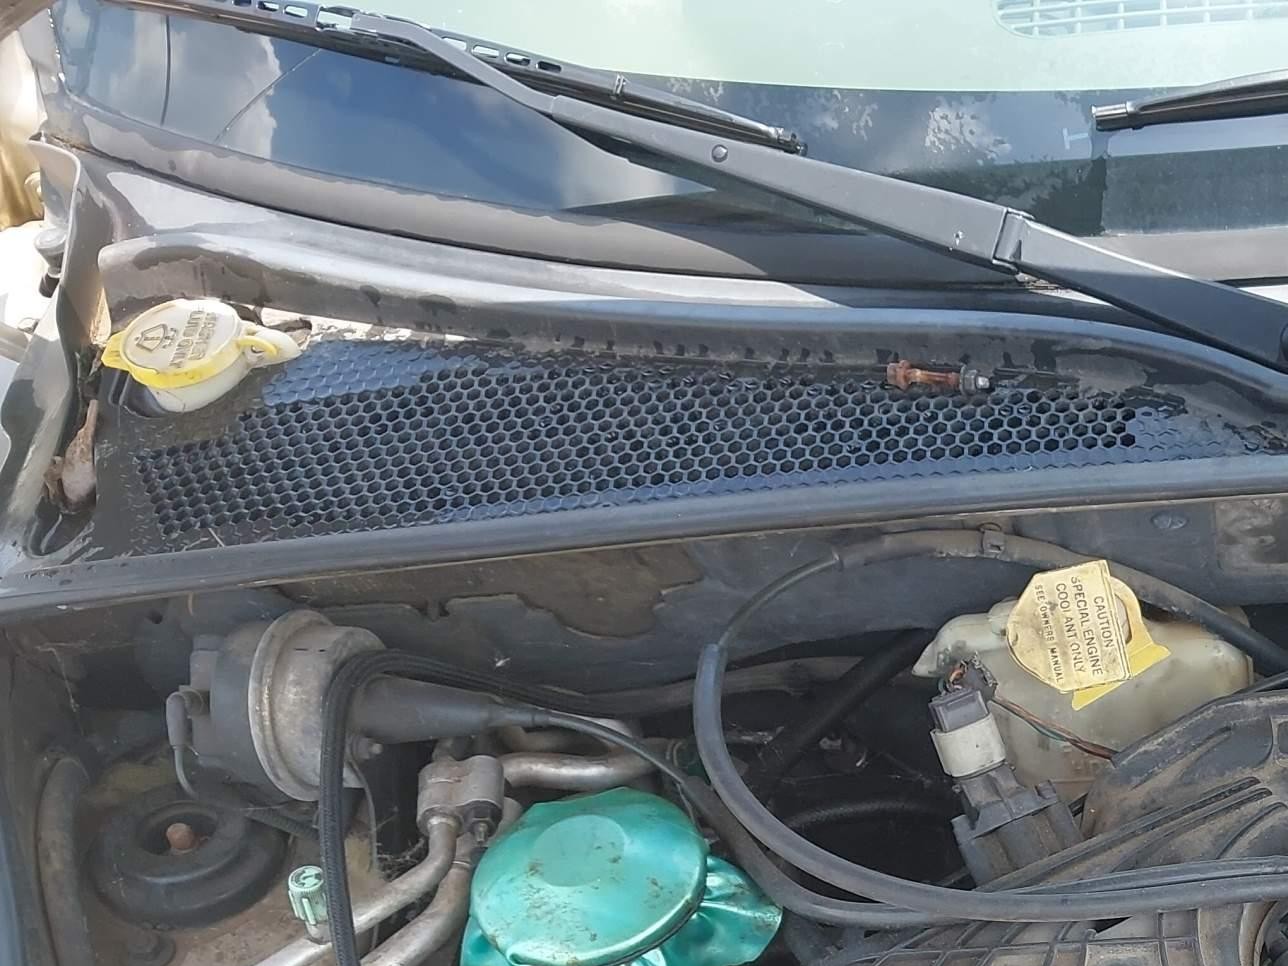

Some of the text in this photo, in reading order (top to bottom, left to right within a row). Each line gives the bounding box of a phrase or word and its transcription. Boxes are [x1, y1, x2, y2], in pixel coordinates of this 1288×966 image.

[1034, 584, 1065, 683] SEE OWNERS MANUAL
[1069, 639, 1087, 674] ONLY
[1070, 576, 1104, 677] SPECIAL ENGINE
[1093, 595, 1115, 649] CAUTION
